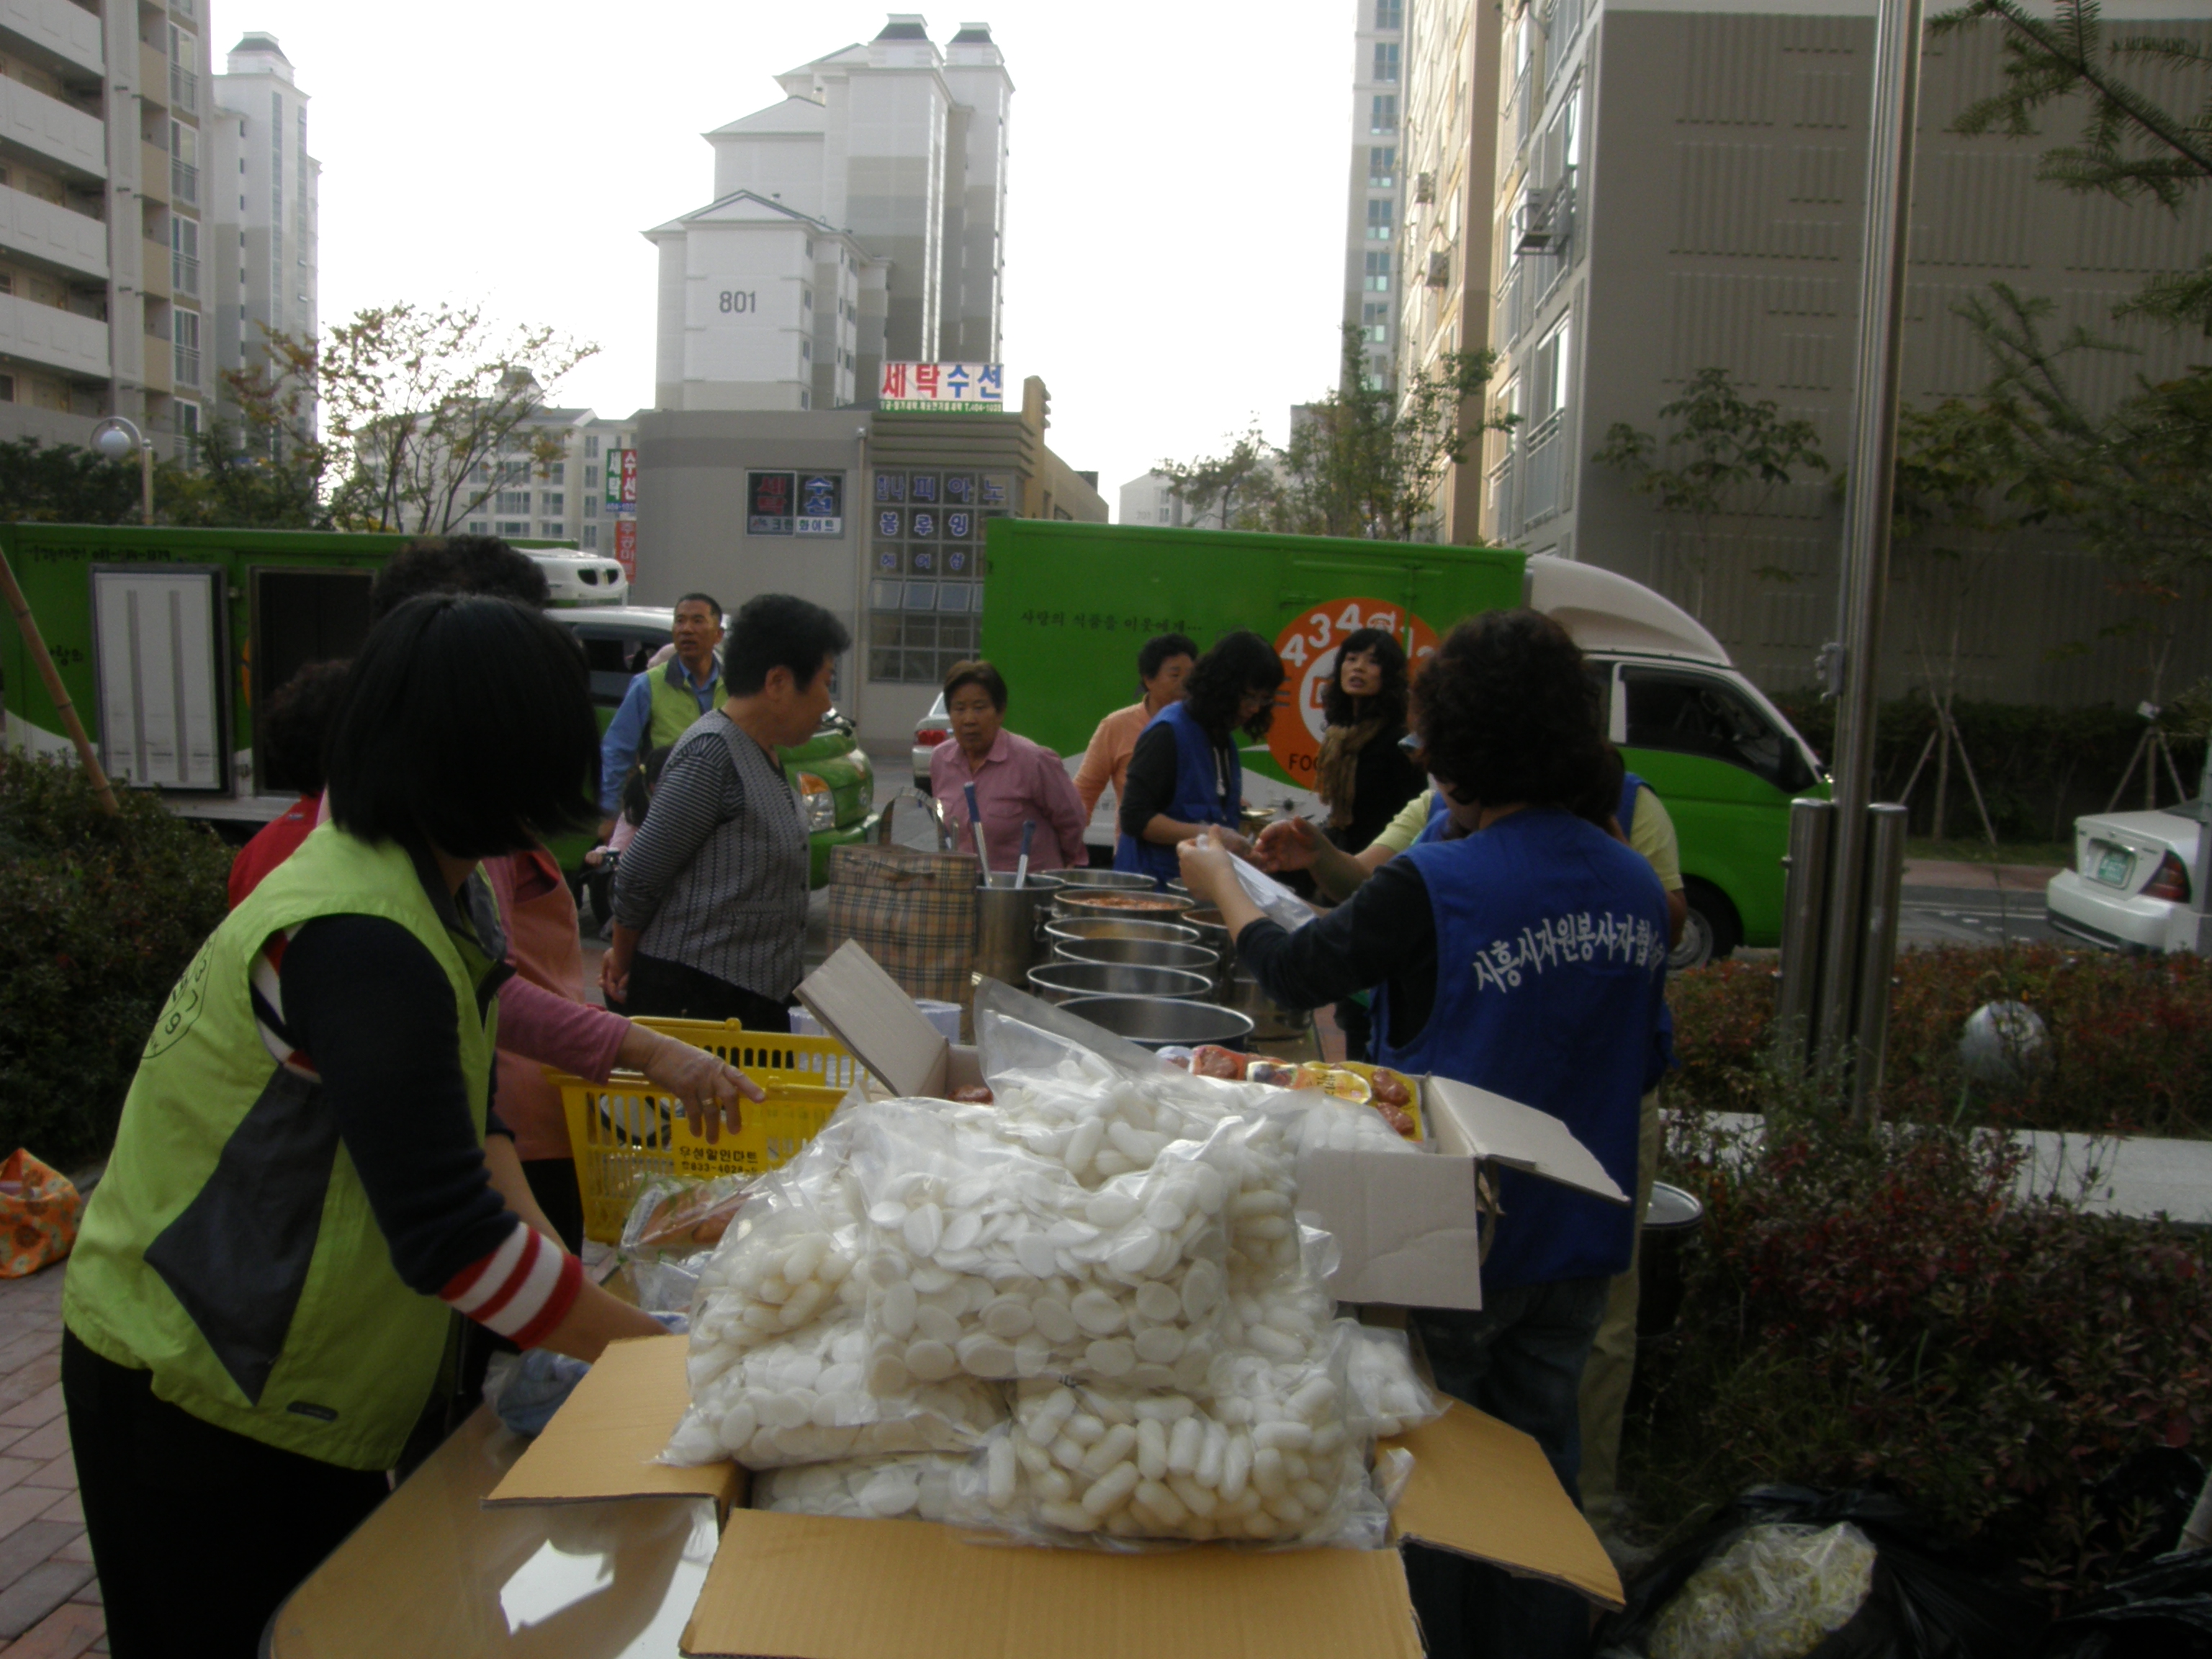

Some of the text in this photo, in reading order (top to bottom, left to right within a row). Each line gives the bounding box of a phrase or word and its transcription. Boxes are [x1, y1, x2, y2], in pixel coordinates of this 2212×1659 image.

[719, 291, 755, 313] 801
[913, 476, 1006, 502] 피아노
[879, 511, 968, 536] 블루밍
[1022, 610, 1064, 627] 사랑의
